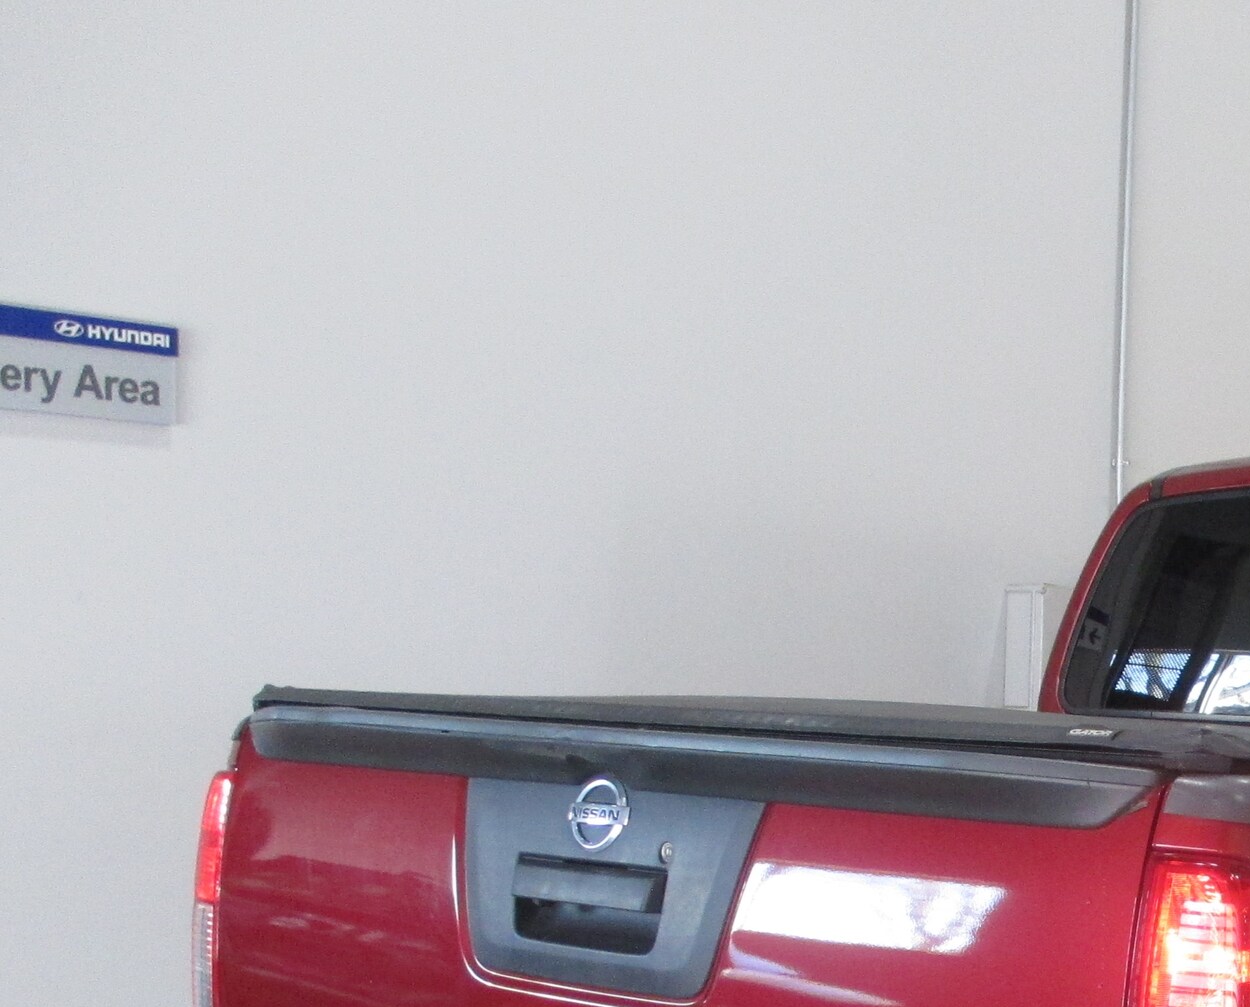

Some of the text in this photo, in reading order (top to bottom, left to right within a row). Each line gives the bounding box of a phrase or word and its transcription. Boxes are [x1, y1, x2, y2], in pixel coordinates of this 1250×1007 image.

[88, 324, 170, 348] HYUNDAI
[0, 364, 160, 406] ery Area
[1069, 728, 1113, 736] GATOR
[572, 806, 620, 821] NISSAN
